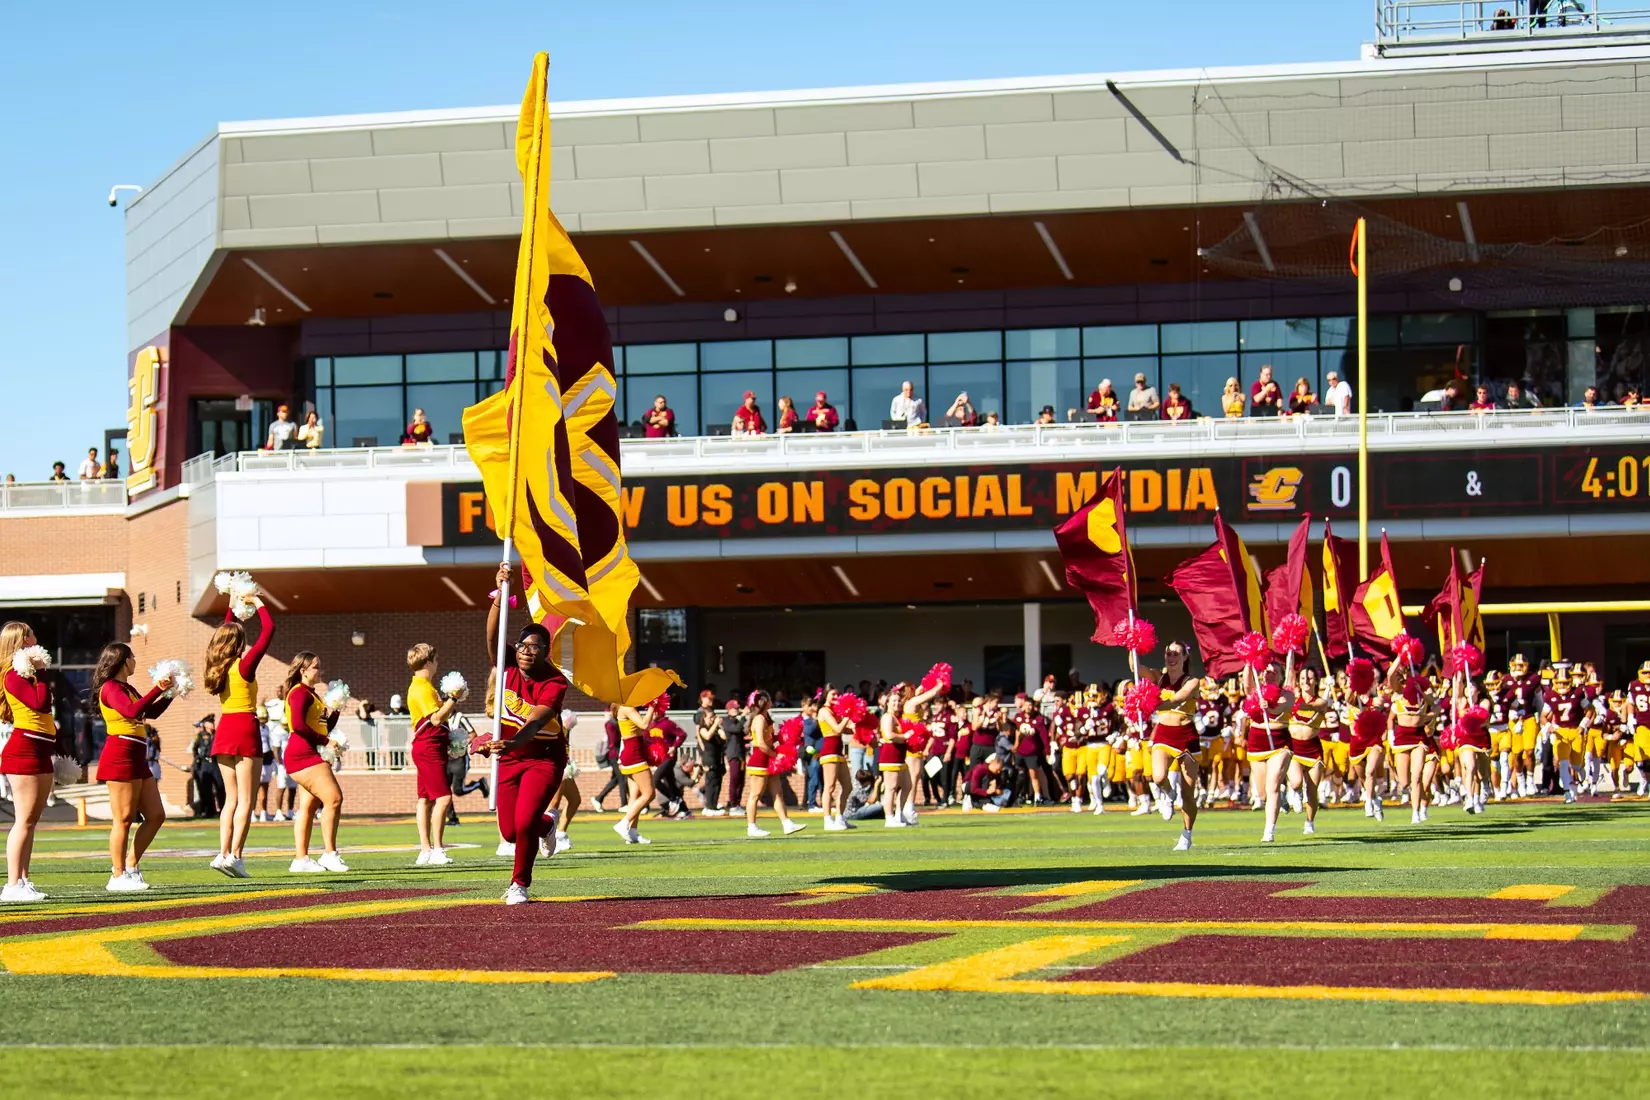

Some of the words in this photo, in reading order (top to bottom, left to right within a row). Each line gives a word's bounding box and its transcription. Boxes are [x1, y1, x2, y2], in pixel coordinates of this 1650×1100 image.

[666, 484, 733, 527] US
[757, 481, 824, 524] ON
[849, 473, 1033, 521] SOCIAL
[1331, 465, 1351, 508] 0
[1465, 470, 1482, 496] &
[1557, 702, 1572, 722] 7
